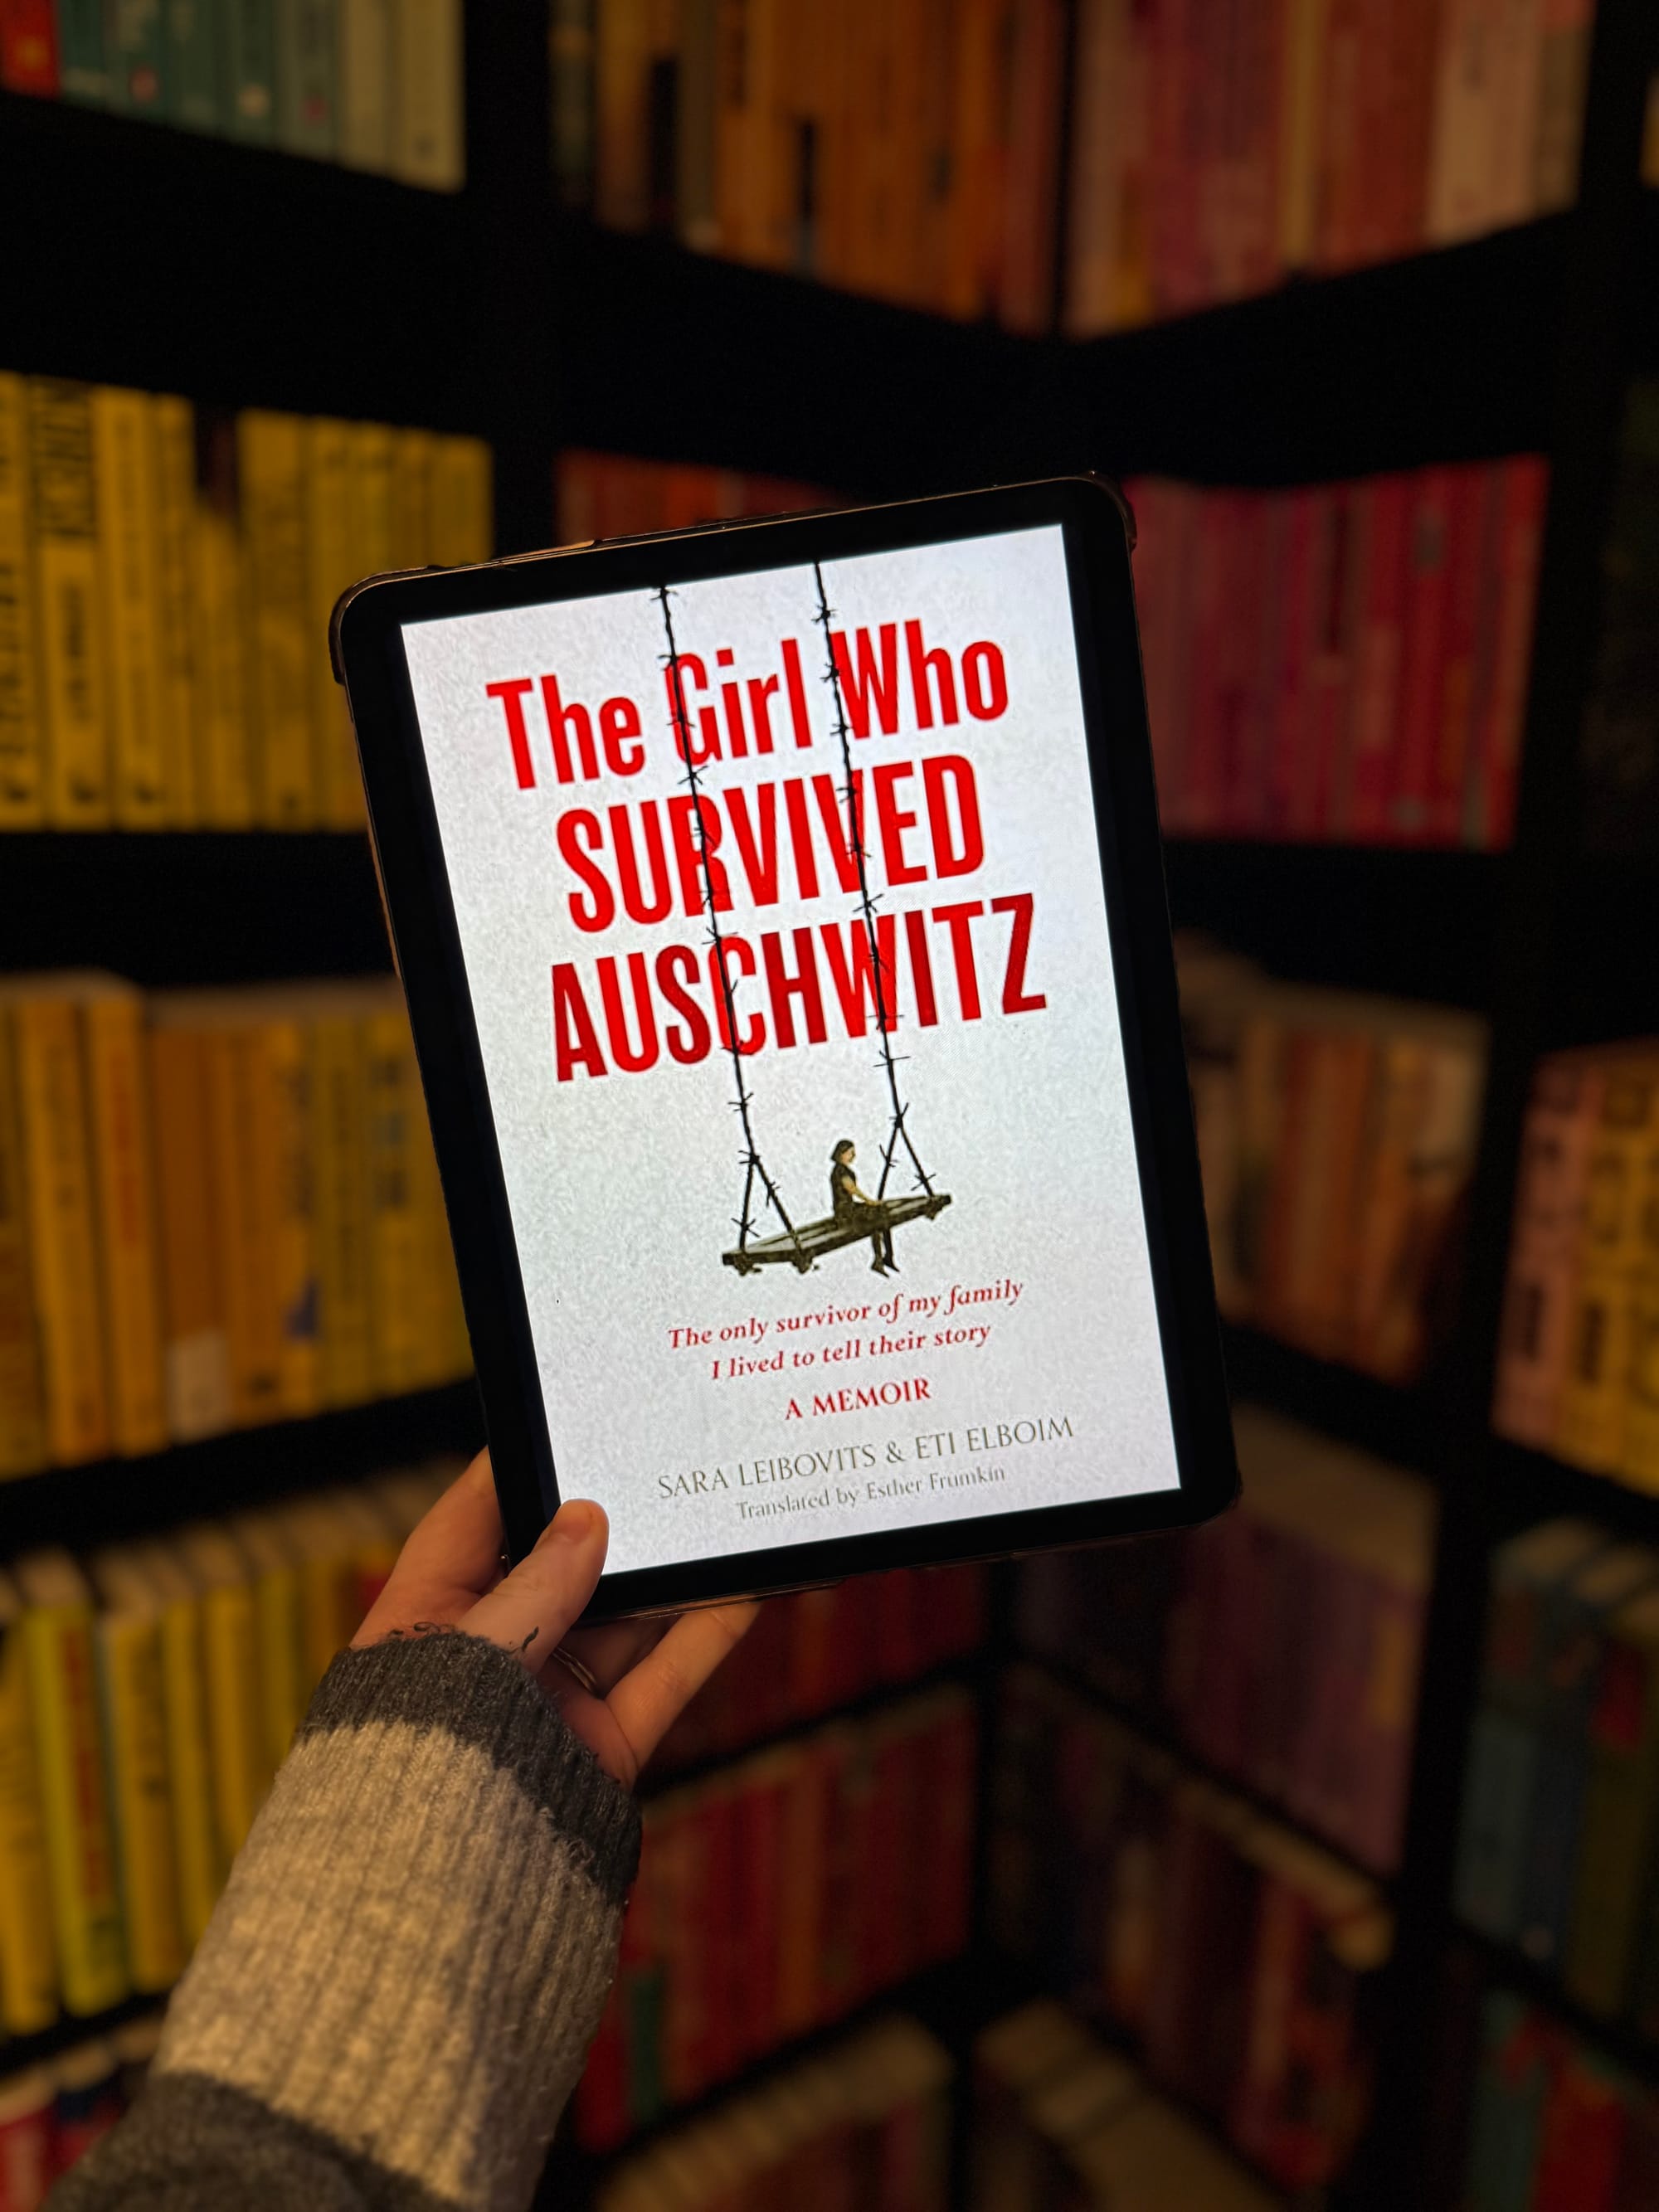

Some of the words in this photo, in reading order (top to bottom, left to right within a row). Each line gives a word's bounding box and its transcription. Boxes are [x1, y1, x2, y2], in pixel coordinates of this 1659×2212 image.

[485, 673, 646, 790] The
[664, 638, 813, 766] Girl
[830, 619, 1009, 740] Who
[556, 754, 985, 933] SURVIVED
[552, 893, 1046, 1082] AUSCHWITZ
[669, 1326, 713, 1350] The
[718, 1316, 769, 1342] only
[776, 1305, 871, 1334] survivor
[877, 1293, 903, 1325] of
[908, 1296, 940, 1317] my
[944, 1277, 1023, 1315] family
[712, 1359, 721, 1380] I
[728, 1349, 785, 1378] lived
[792, 1352, 815, 1368] to
[822, 1339, 861, 1364] tell
[868, 1330, 927, 1356] their
[934, 1326, 990, 1348] story
[786, 1398, 804, 1421] A
[811, 1377, 931, 1417] MEMOIR
[658, 1467, 730, 1500] SARA
[737, 1443, 877, 1487] LEIBOVITS
[885, 1440, 907, 1465] &
[915, 1432, 956, 1460] ETI
[966, 1416, 1074, 1452] ELBOIM
[735, 1488, 830, 1520] Translated
[835, 1487, 860, 1509] by
[866, 1479, 922, 1500] Esther
[929, 1466, 1005, 1490] Frumkin
